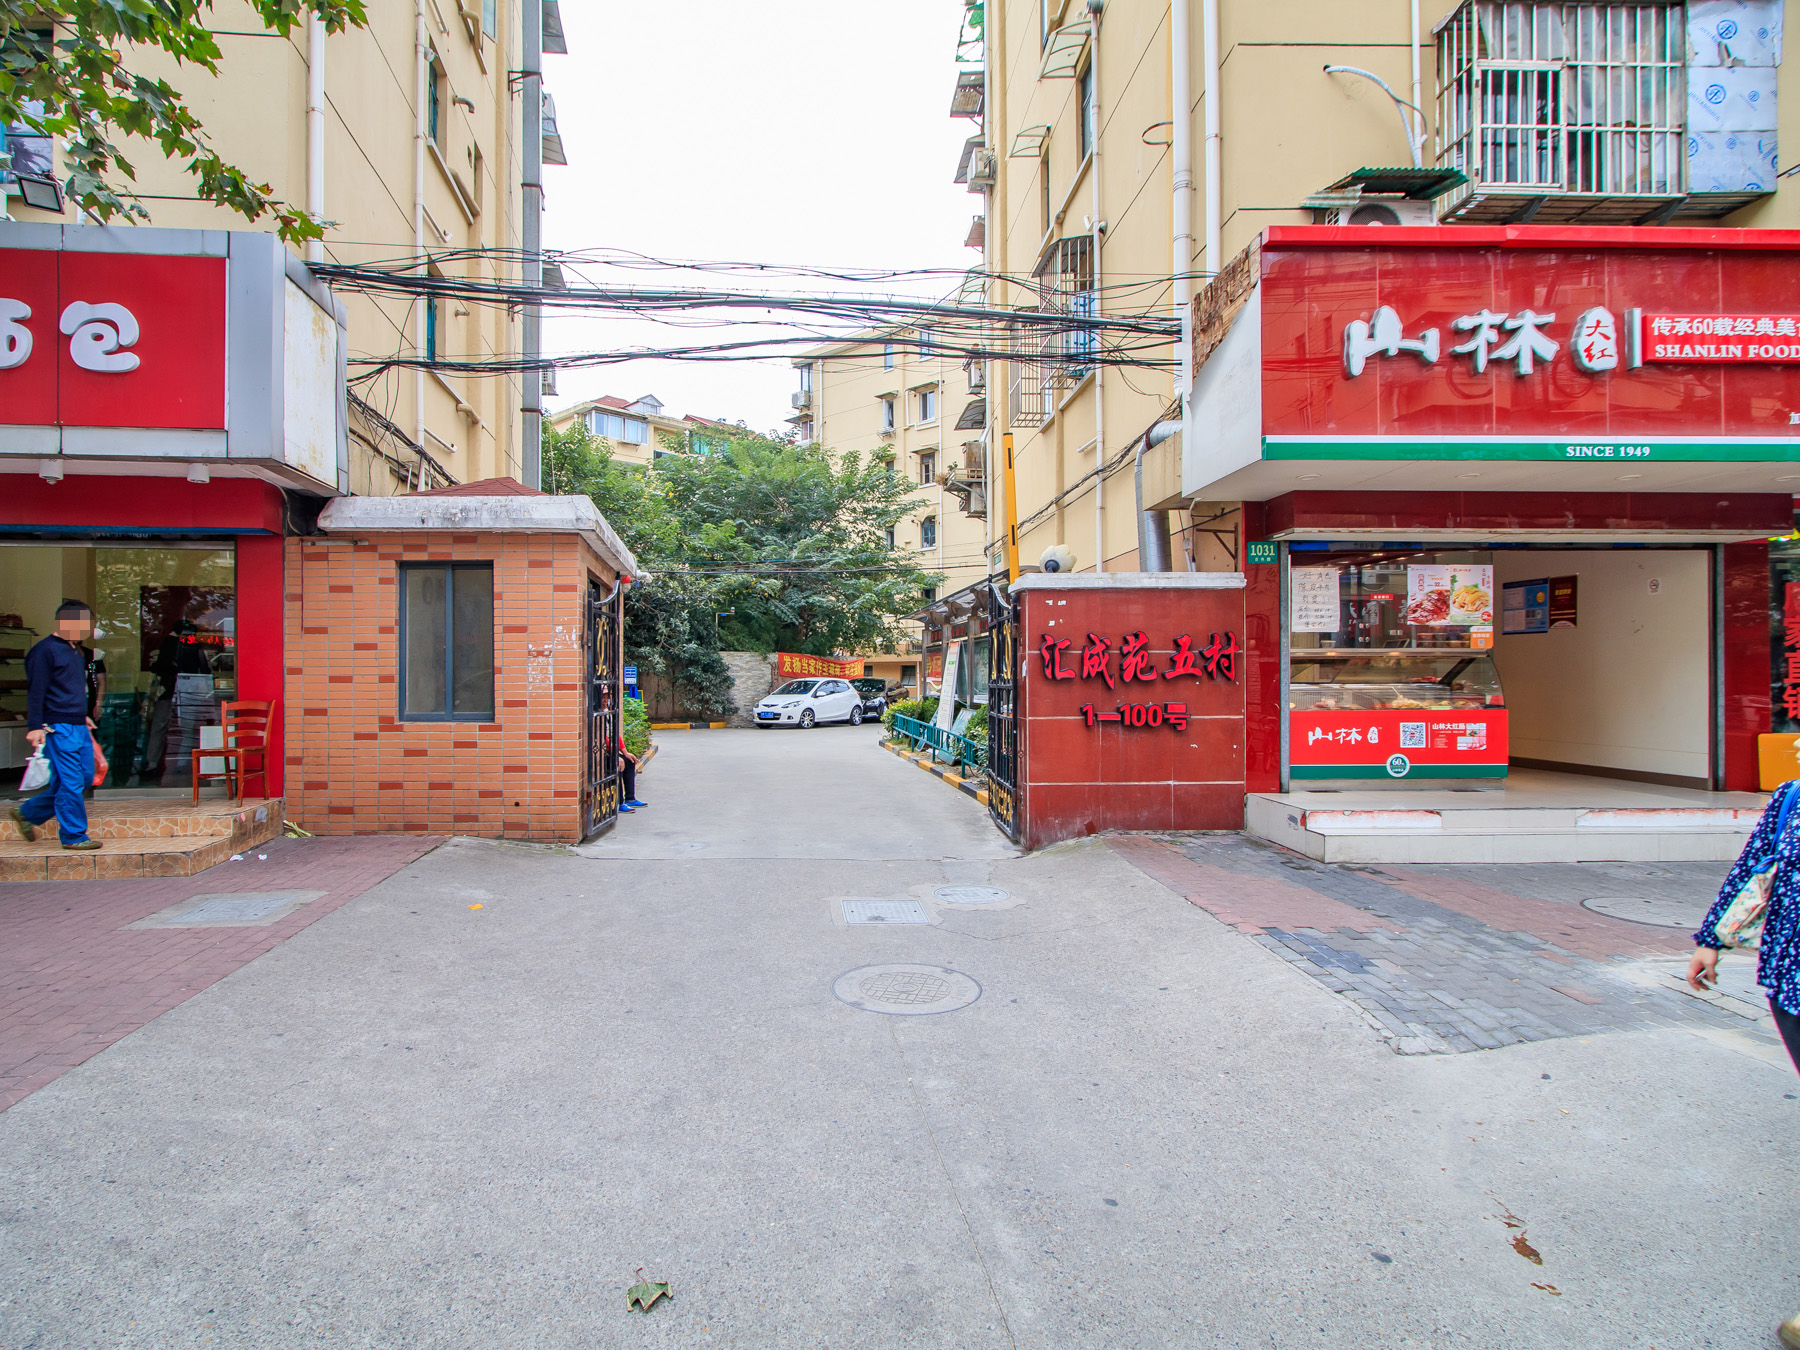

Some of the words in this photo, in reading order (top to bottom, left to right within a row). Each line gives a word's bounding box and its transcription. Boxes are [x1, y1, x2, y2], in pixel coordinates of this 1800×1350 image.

[1651, 316, 1800, 336] 传承60载经典美
[1344, 305, 1560, 377] 山林
[1584, 318, 1614, 363] 大红
[1655, 344, 1743, 358] SHANLIN
[1566, 446, 1614, 456] SINCE
[1619, 446, 1650, 457] 1949
[1250, 545, 1275, 556] 1031
[1040, 630, 1240, 690] 汇成苑五村
[1308, 727, 1362, 746] 山林
